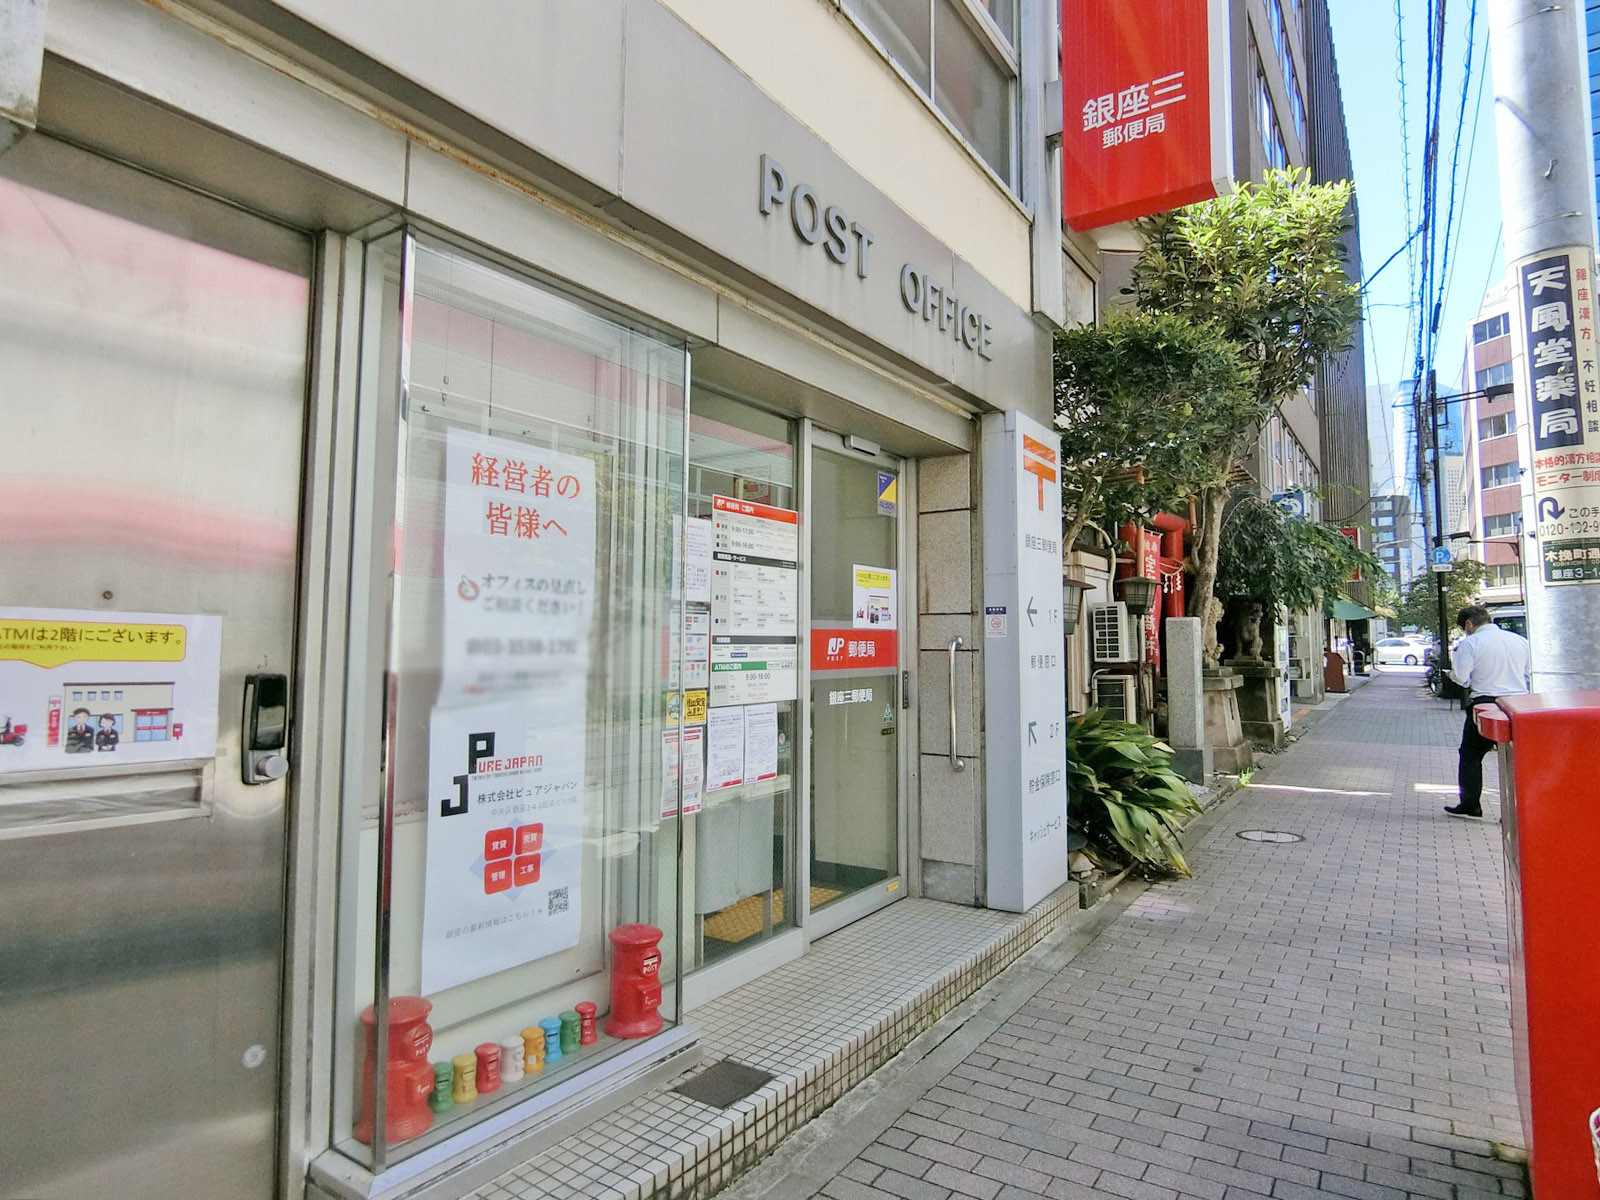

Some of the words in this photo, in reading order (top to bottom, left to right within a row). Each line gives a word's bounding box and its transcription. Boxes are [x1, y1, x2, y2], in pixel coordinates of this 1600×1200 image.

[1082, 71, 1186, 132] 銀座三
[1102, 112, 1165, 149] 郵便局
[760, 153, 874, 279] POST
[900, 263, 992, 362] OFFICE
[1527, 265, 1579, 440] 天風堂薬局
[471, 452, 581, 499] 経営者の
[486, 502, 568, 539] 皆様へ
[1552, 567, 1600, 580] 銀座3-1
[0, 627, 182, 645] TMは2階にございます。
[848, 640, 876, 658] 郵便局
[829, 688, 873, 706] 銀座三郵便局
[477, 781, 578, 804] 株式会社ピュアジャパン
